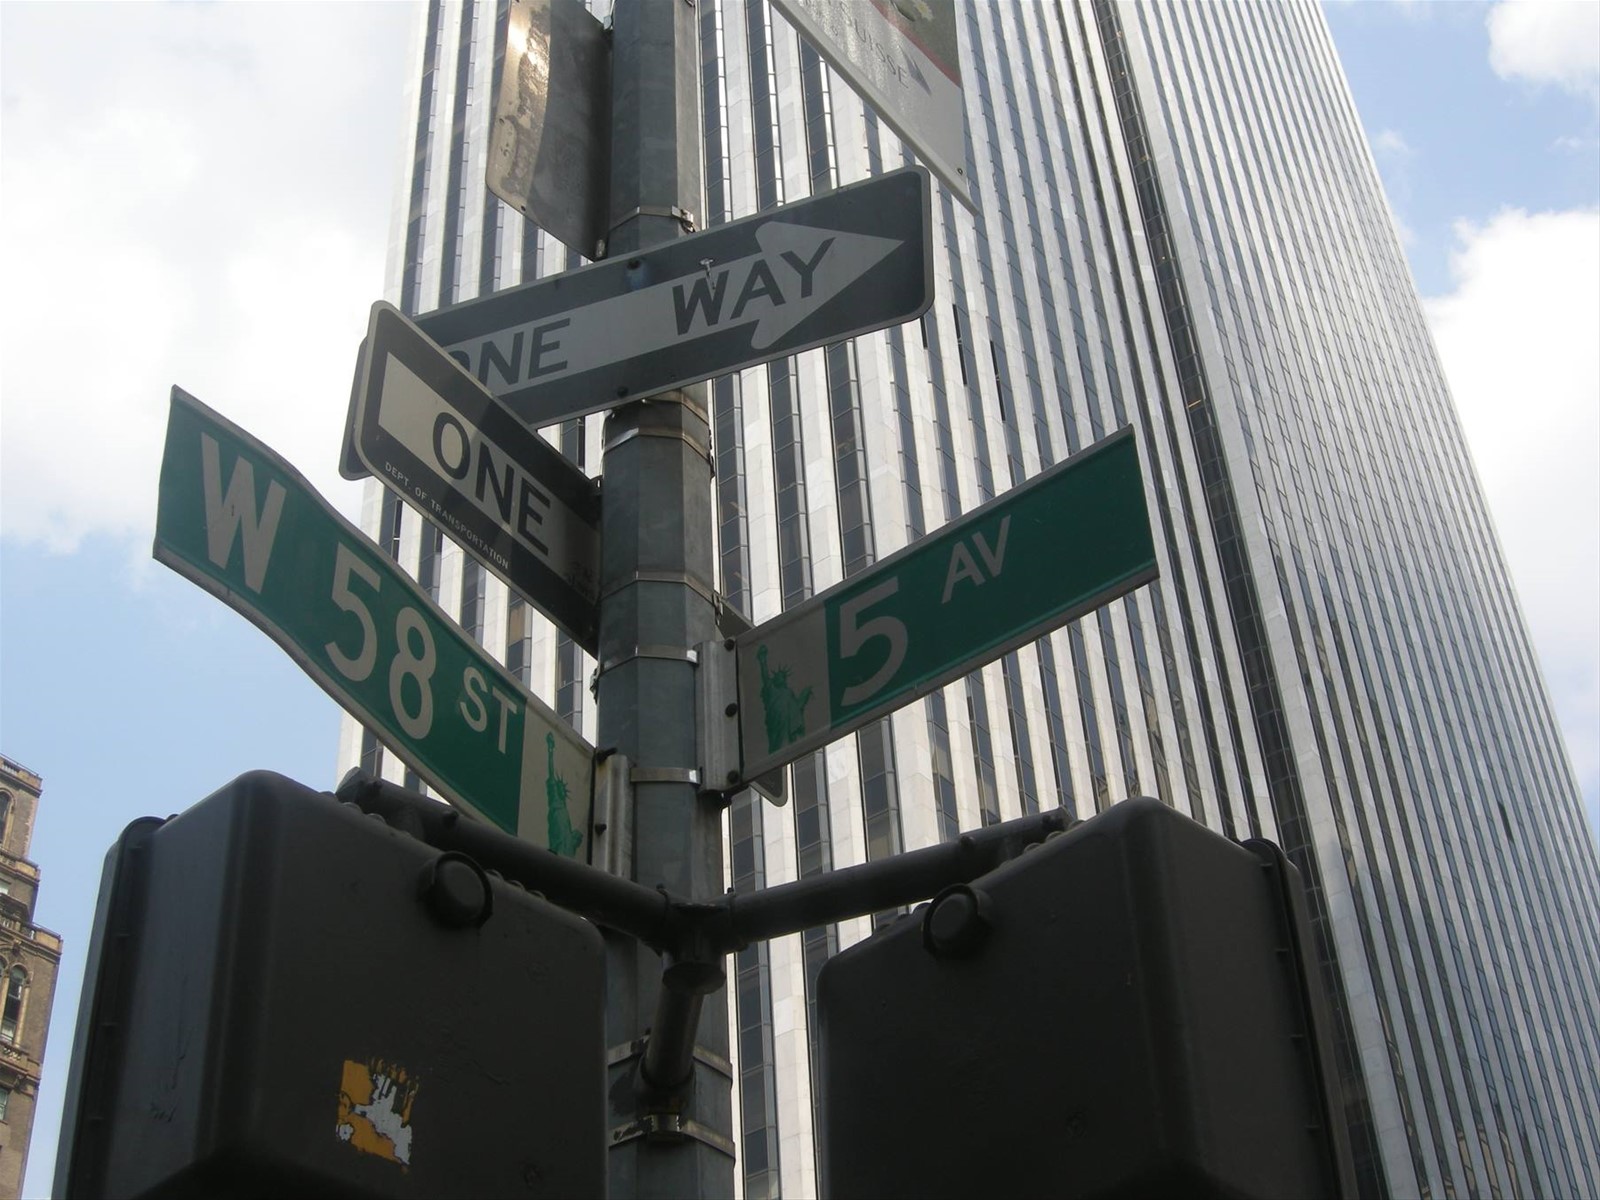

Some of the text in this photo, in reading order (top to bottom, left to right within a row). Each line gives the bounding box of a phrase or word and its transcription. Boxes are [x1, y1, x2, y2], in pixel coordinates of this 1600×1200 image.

[672, 237, 836, 335] WAY
[385, 461, 509, 569] DEPT. OF TRANSPORTATION
[432, 412, 551, 557] ONE
[201, 431, 517, 754] W 58 ST
[839, 514, 1011, 707] 5 AV
